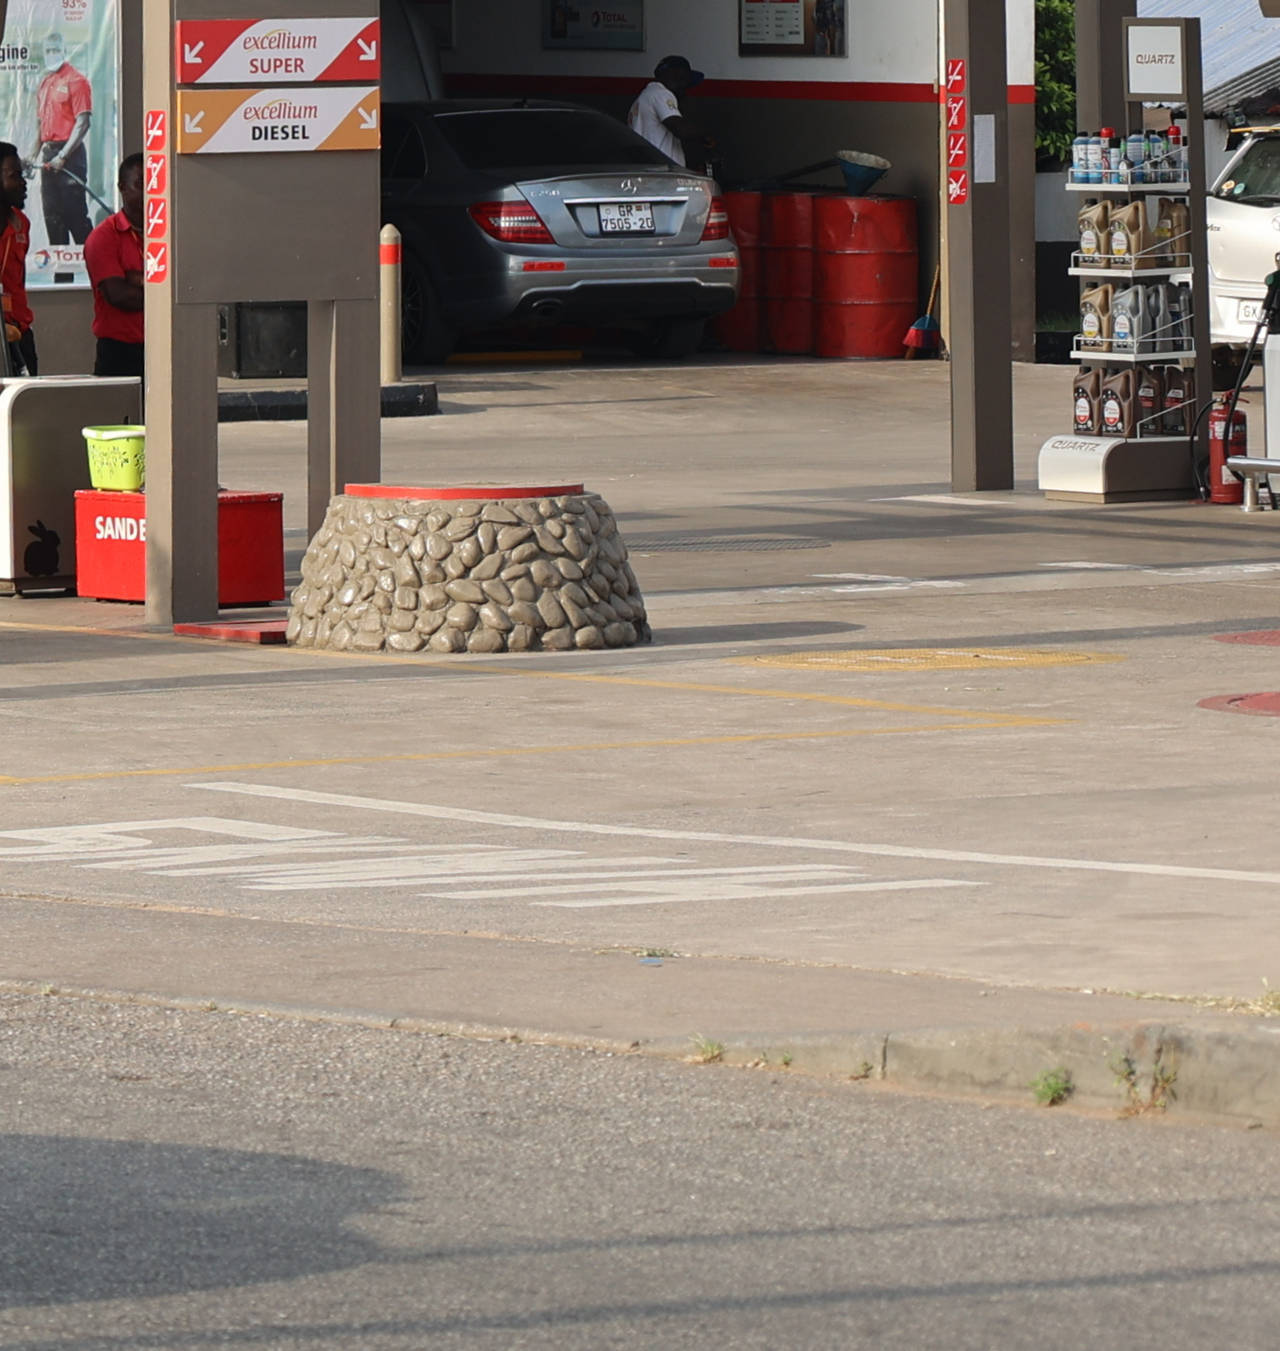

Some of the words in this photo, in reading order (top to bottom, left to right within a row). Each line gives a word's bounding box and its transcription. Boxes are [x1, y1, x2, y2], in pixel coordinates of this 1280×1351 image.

[243, 30, 317, 51] excellium
[249, 57, 304, 75] SUPER
[1136, 54, 1175, 65] QUARTZ
[243, 99, 318, 121] excellium
[251, 124, 310, 141] DIESEL
[618, 205, 633, 217] GR
[1050, 440, 1101, 453] QUARTZ
[95, 516, 137, 540] SAND
